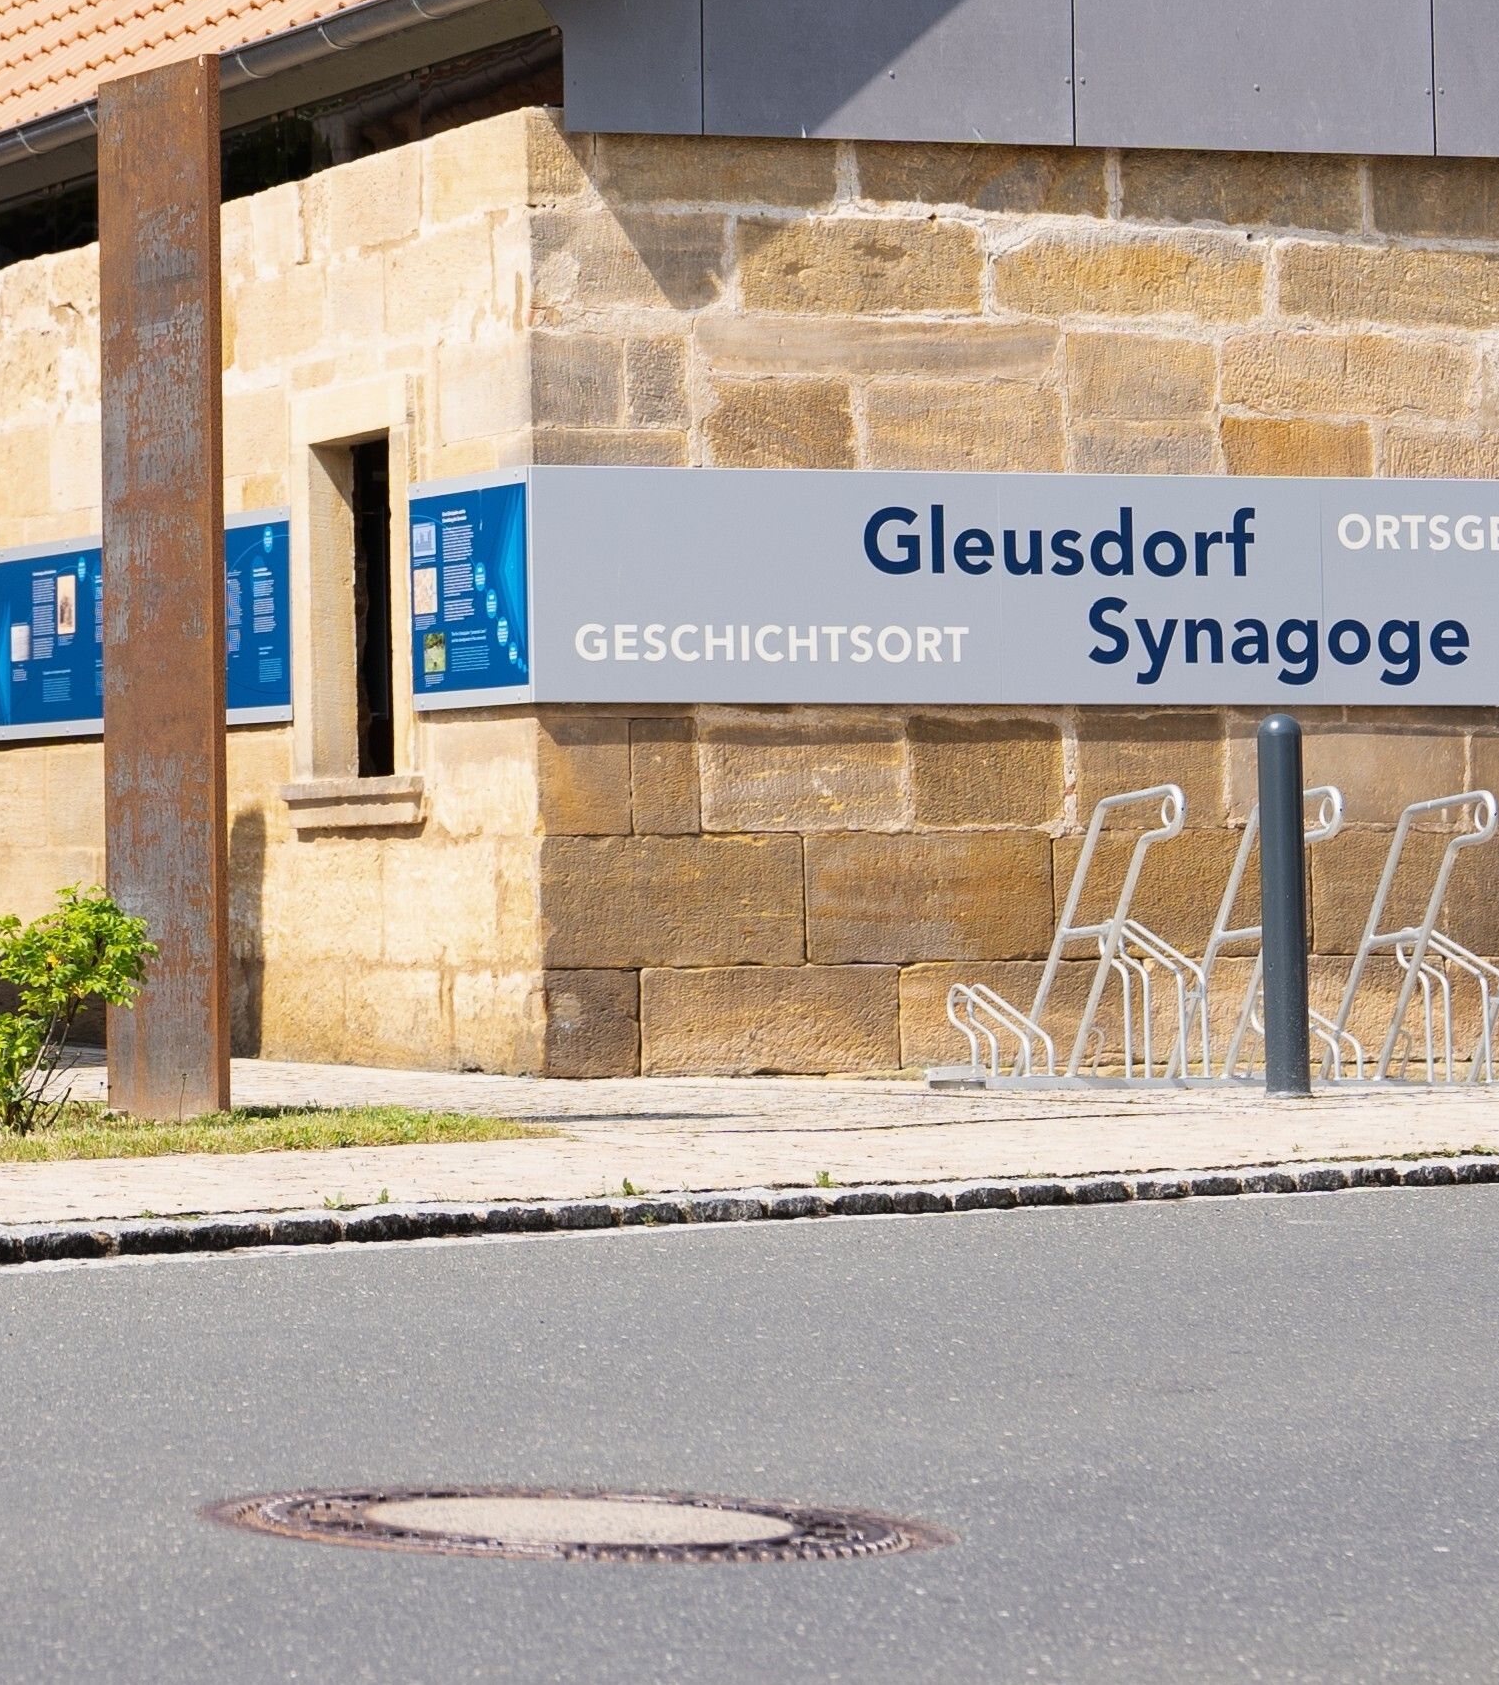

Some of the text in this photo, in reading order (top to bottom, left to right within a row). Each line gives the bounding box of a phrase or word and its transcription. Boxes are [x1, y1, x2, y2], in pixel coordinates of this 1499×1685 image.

[864, 505, 1255, 577] Gleusdorf
[574, 622, 970, 665] GESCHICHTSORT
[1089, 597, 1469, 685] Synagoge
